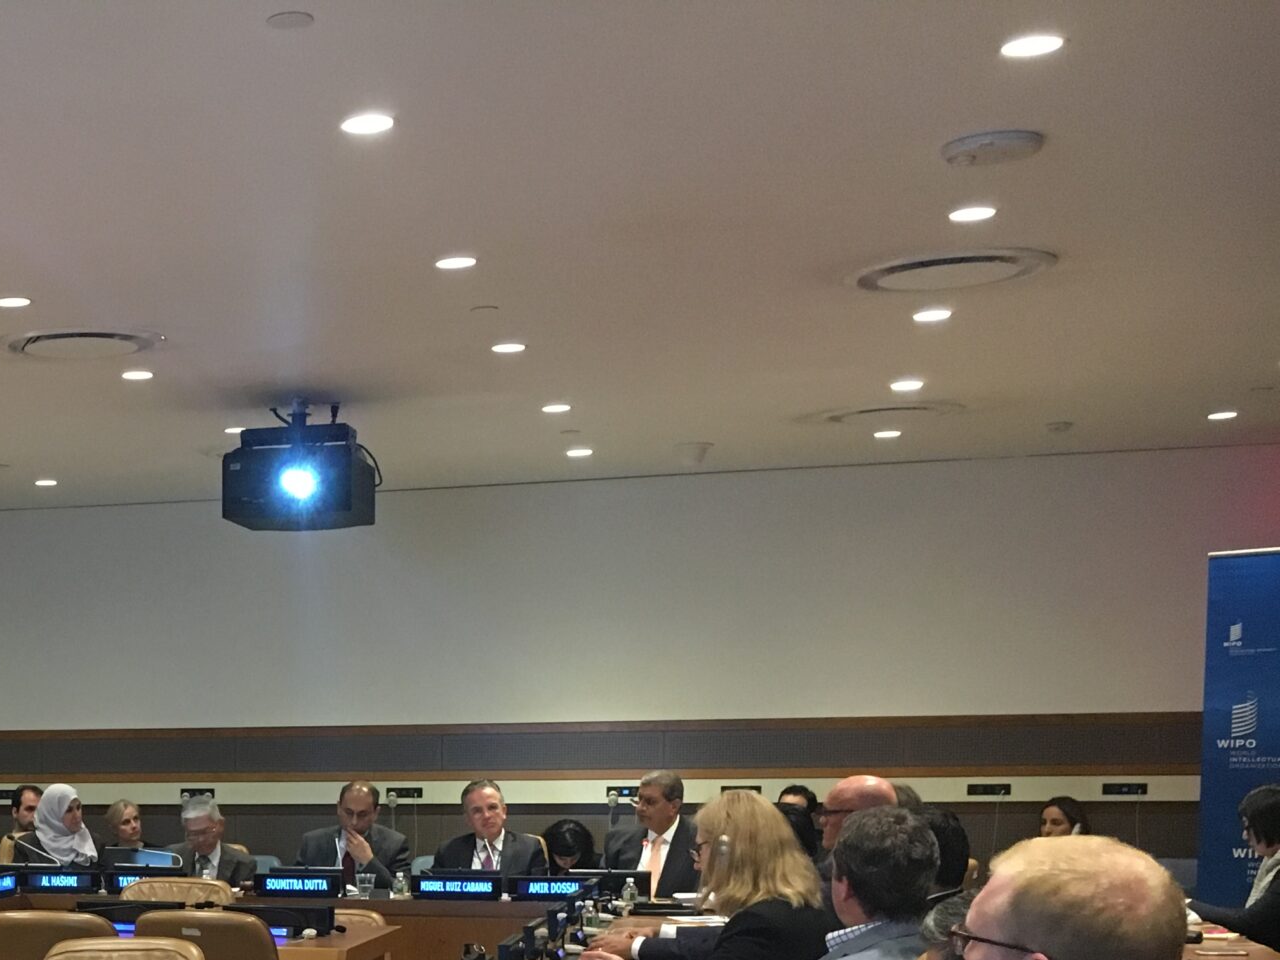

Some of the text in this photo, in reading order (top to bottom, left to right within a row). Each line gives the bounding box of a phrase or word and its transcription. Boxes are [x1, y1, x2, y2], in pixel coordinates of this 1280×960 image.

[1216, 739, 1256, 749] WIPO
[266, 878, 328, 891] SOUMITRA DUTTA
[420, 880, 493, 893] MIGUEL RUIZ CABANAS
[528, 882, 549, 894] AMIR
